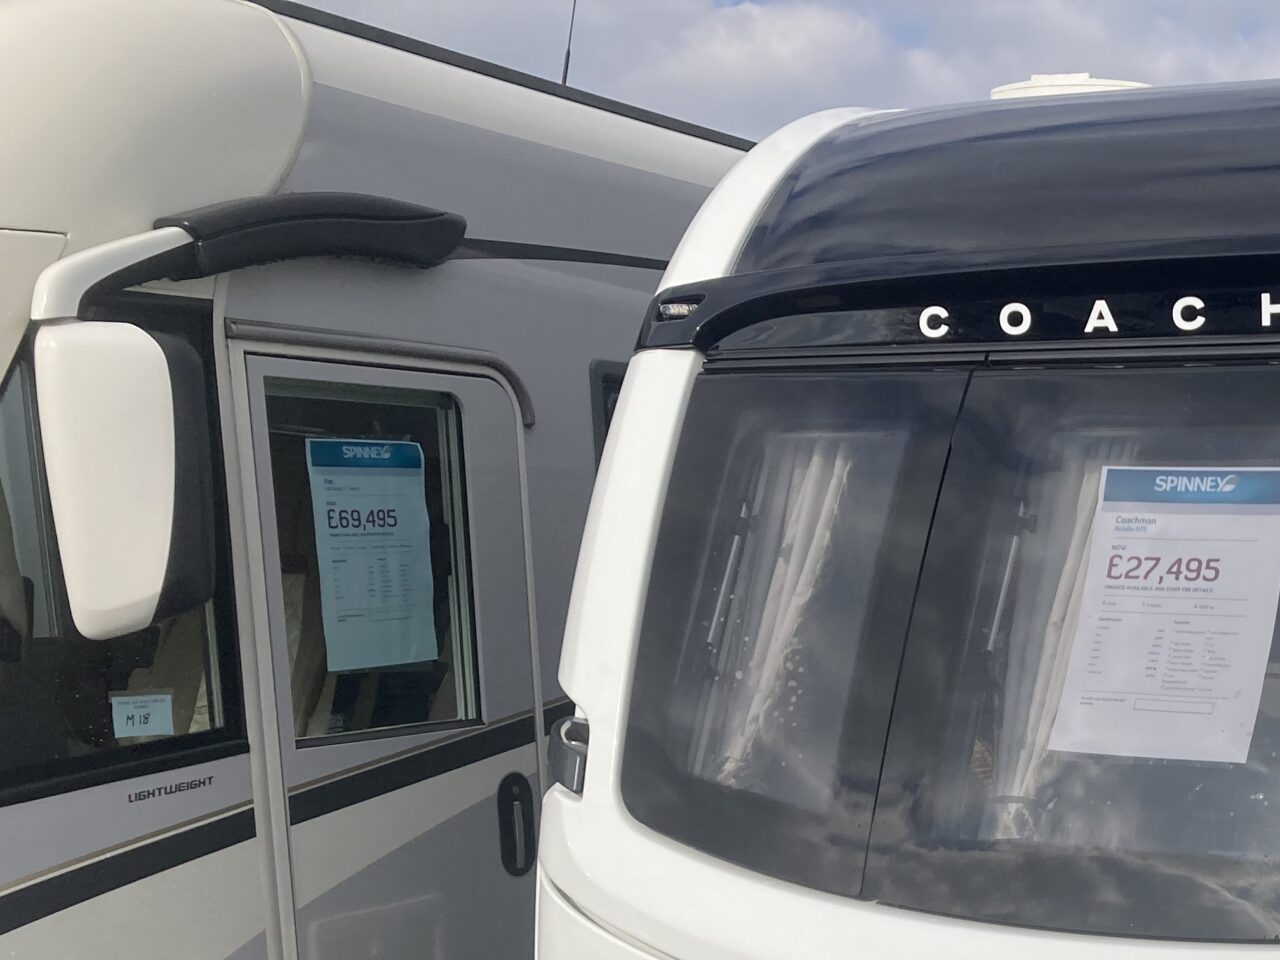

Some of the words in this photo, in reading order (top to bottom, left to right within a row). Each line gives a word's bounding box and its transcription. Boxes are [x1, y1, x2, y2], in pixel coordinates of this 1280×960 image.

[342, 445, 389, 459] SPINNEY
[1154, 475, 1232, 492] SPINNEY
[327, 508, 398, 531] £69,495
[1115, 515, 1157, 525] Coachman
[1106, 554, 1221, 585] £27,495
[128, 776, 214, 803] LIGHTWEIGHT
